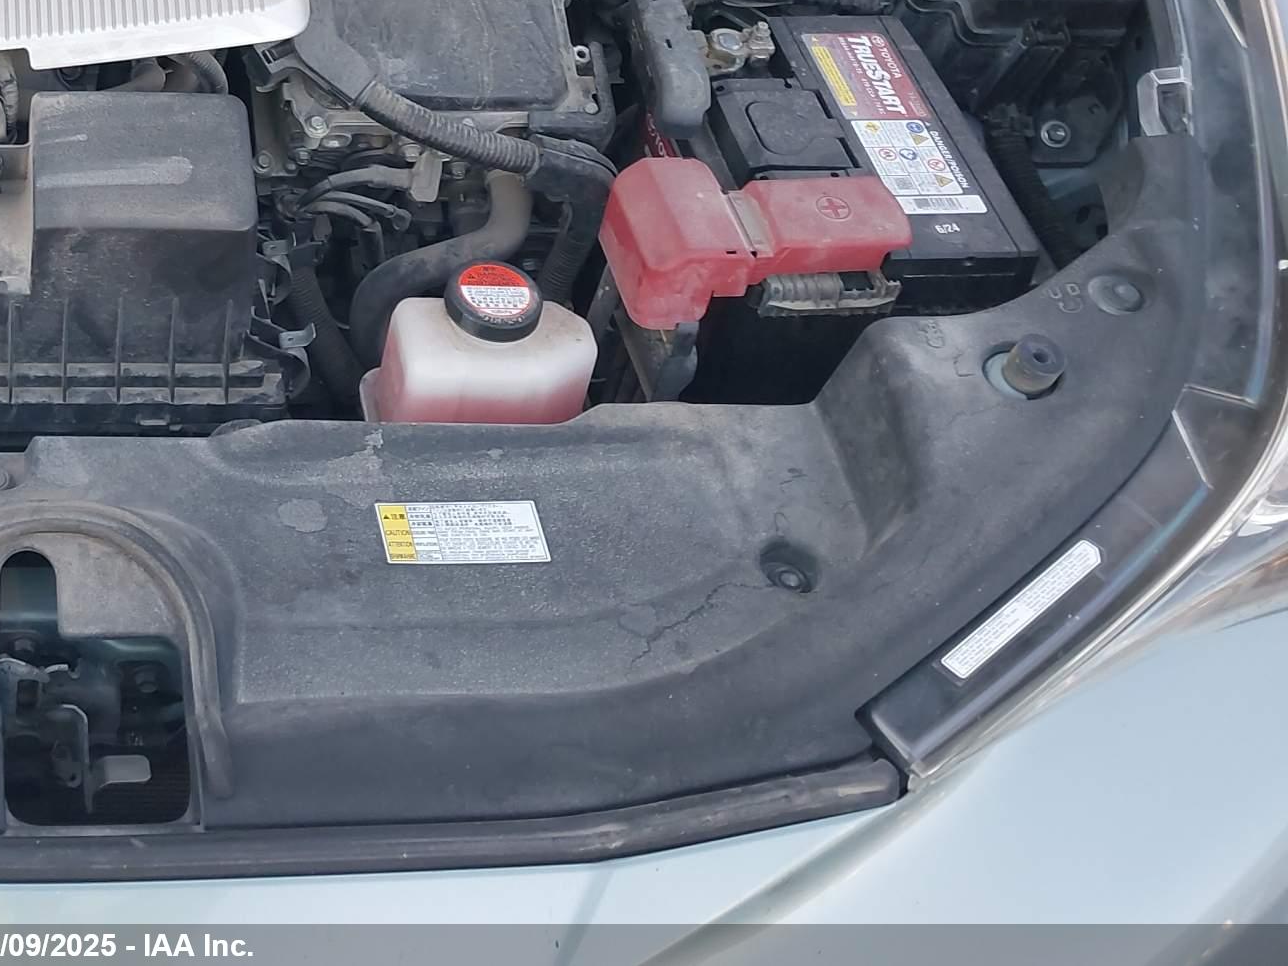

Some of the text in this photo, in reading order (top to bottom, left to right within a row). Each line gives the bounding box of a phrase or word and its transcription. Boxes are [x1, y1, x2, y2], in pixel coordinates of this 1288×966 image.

[876, 47, 904, 78] TOYOTA
[929, 130, 971, 189] DANGER/POISON
[934, 223, 961, 234] 6/24
